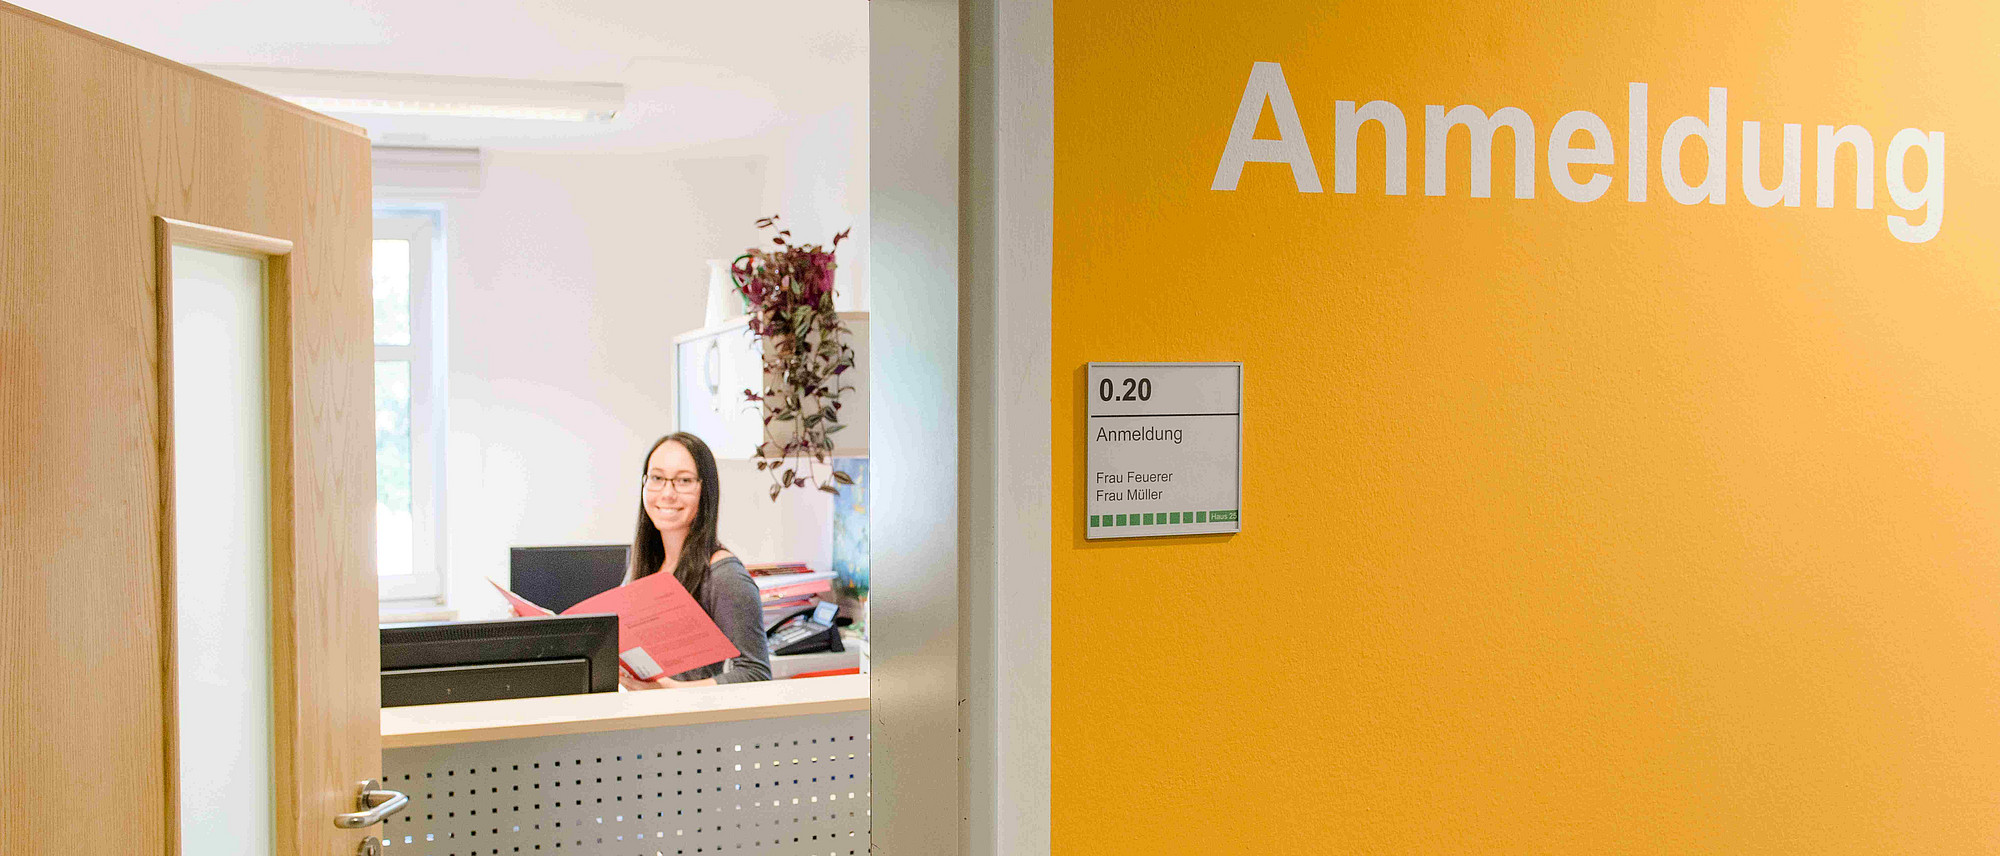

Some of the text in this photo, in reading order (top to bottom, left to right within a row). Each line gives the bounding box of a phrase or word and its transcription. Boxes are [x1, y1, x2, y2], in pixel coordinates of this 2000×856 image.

[1210, 60, 1946, 243] Anmeldung
[1099, 377, 1152, 402] 0.20
[1096, 426, 1183, 444] Anmeldung
[1096, 471, 1173, 484] Frau Feuerer
[1096, 488, 1163, 501] Frau Müller
[1210, 511, 1237, 520] Haus 25
